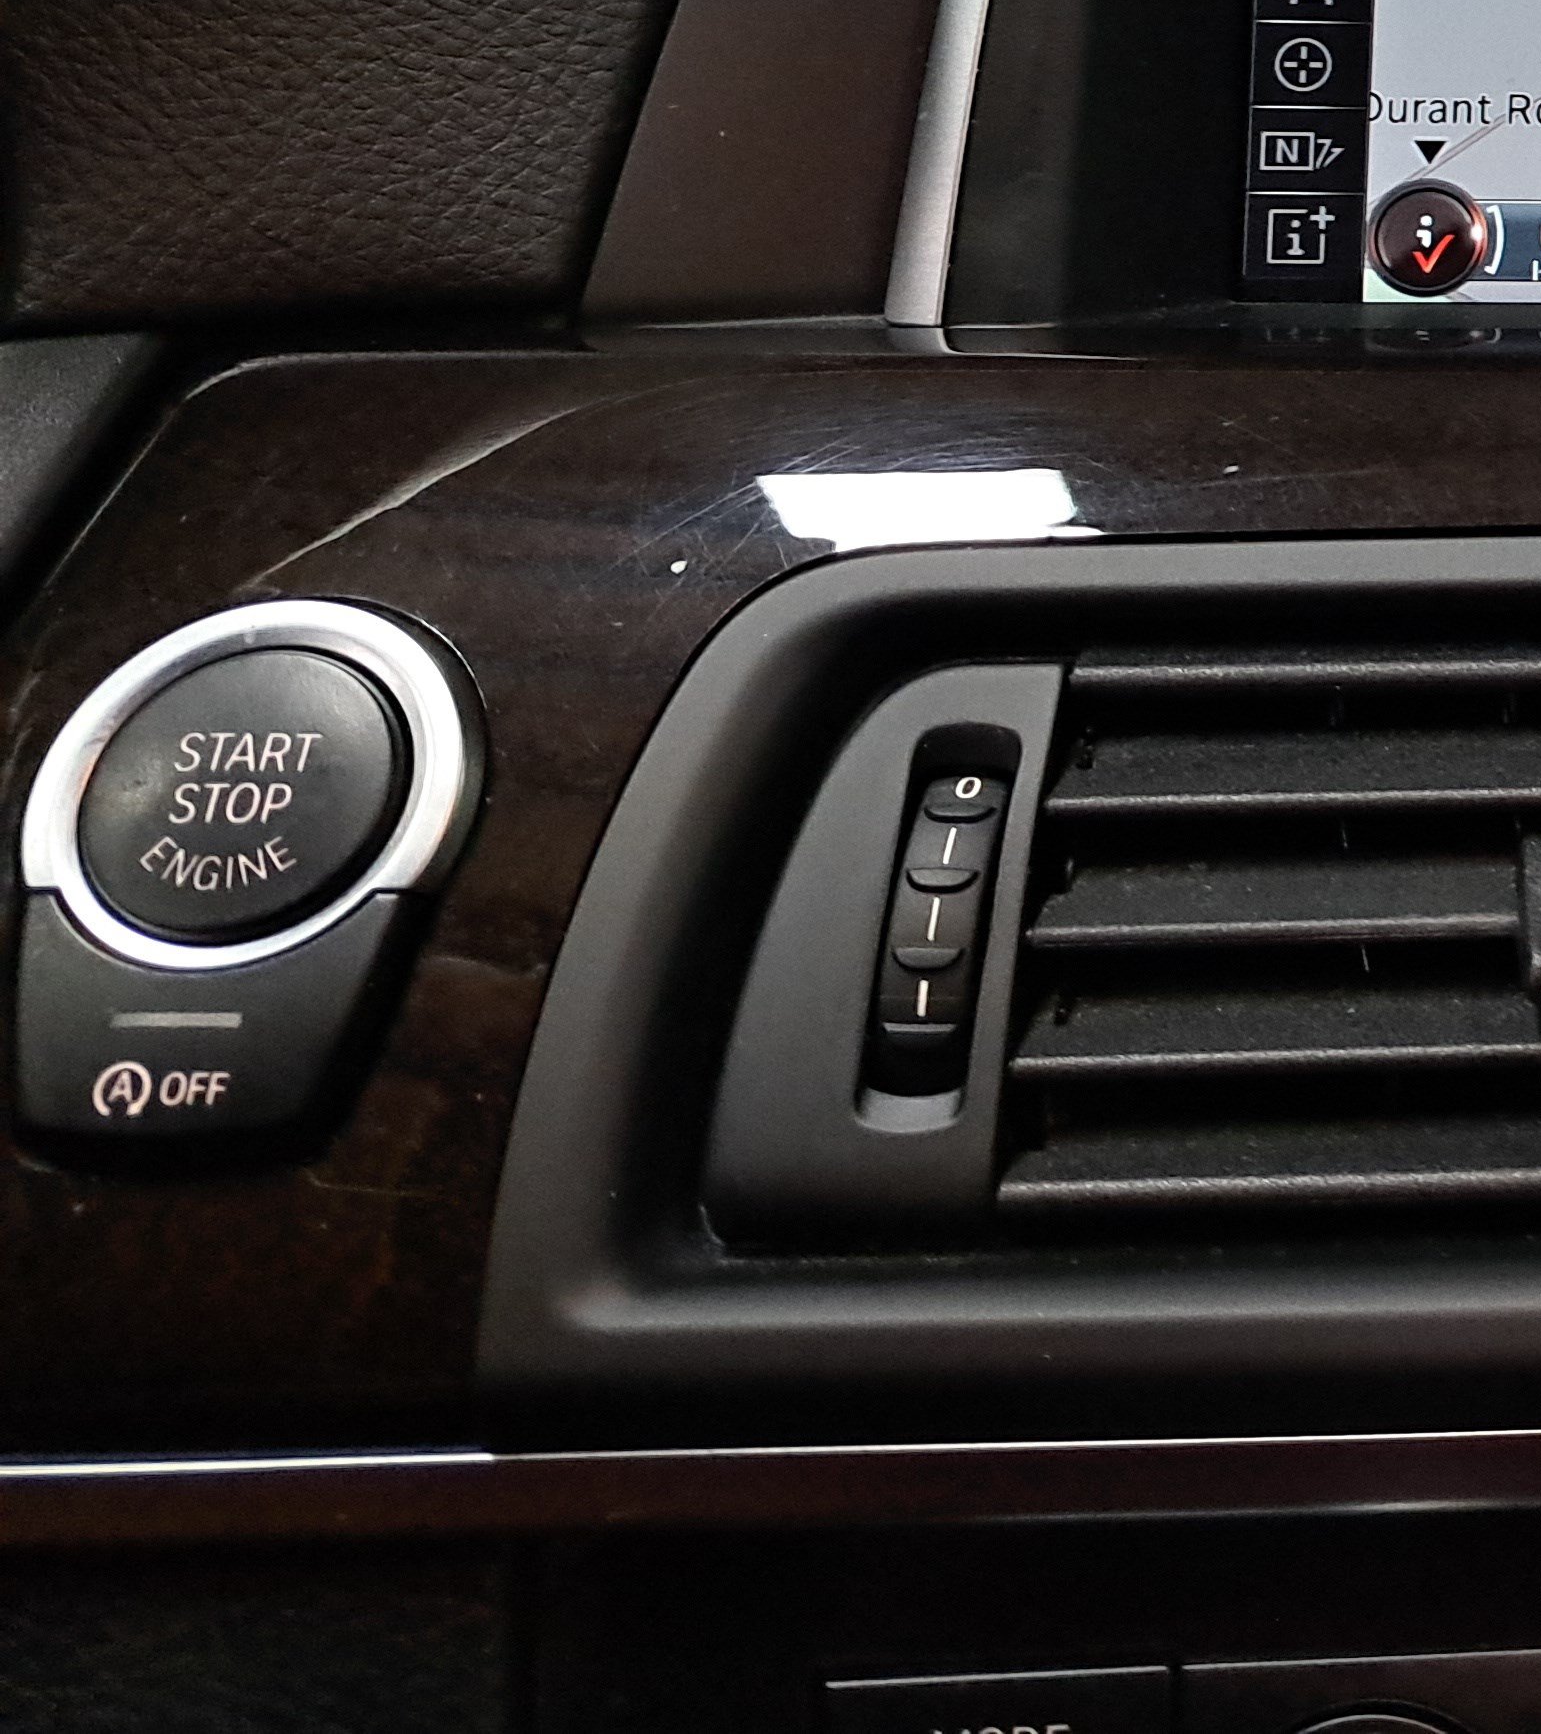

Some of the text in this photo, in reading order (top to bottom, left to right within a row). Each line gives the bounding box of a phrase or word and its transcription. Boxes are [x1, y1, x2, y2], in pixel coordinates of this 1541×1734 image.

[1369, 91, 1491, 125] Durant
[173, 732, 322, 772] START
[168, 782, 292, 824] STOP
[139, 836, 296, 891] ENGINE
[159, 1071, 230, 1106] OFF
